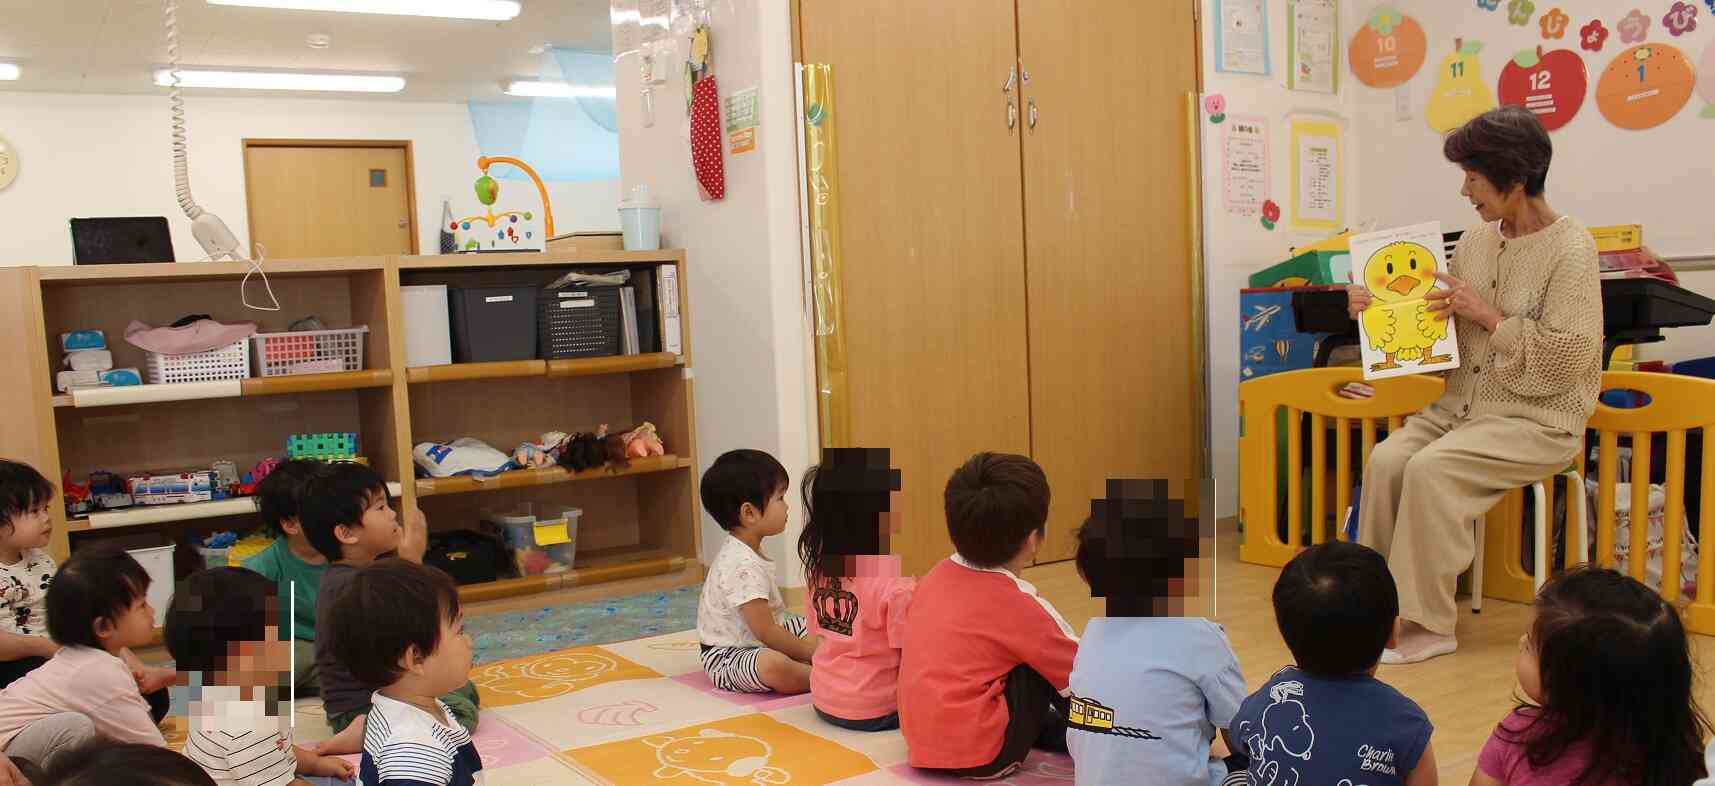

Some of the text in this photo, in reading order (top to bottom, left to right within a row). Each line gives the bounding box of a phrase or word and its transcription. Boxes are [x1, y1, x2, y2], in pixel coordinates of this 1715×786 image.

[1375, 36, 1396, 53] 10
[1450, 61, 1464, 78] 11
[1529, 70, 1552, 90] 12
[1360, 758, 1396, 775] Brown
